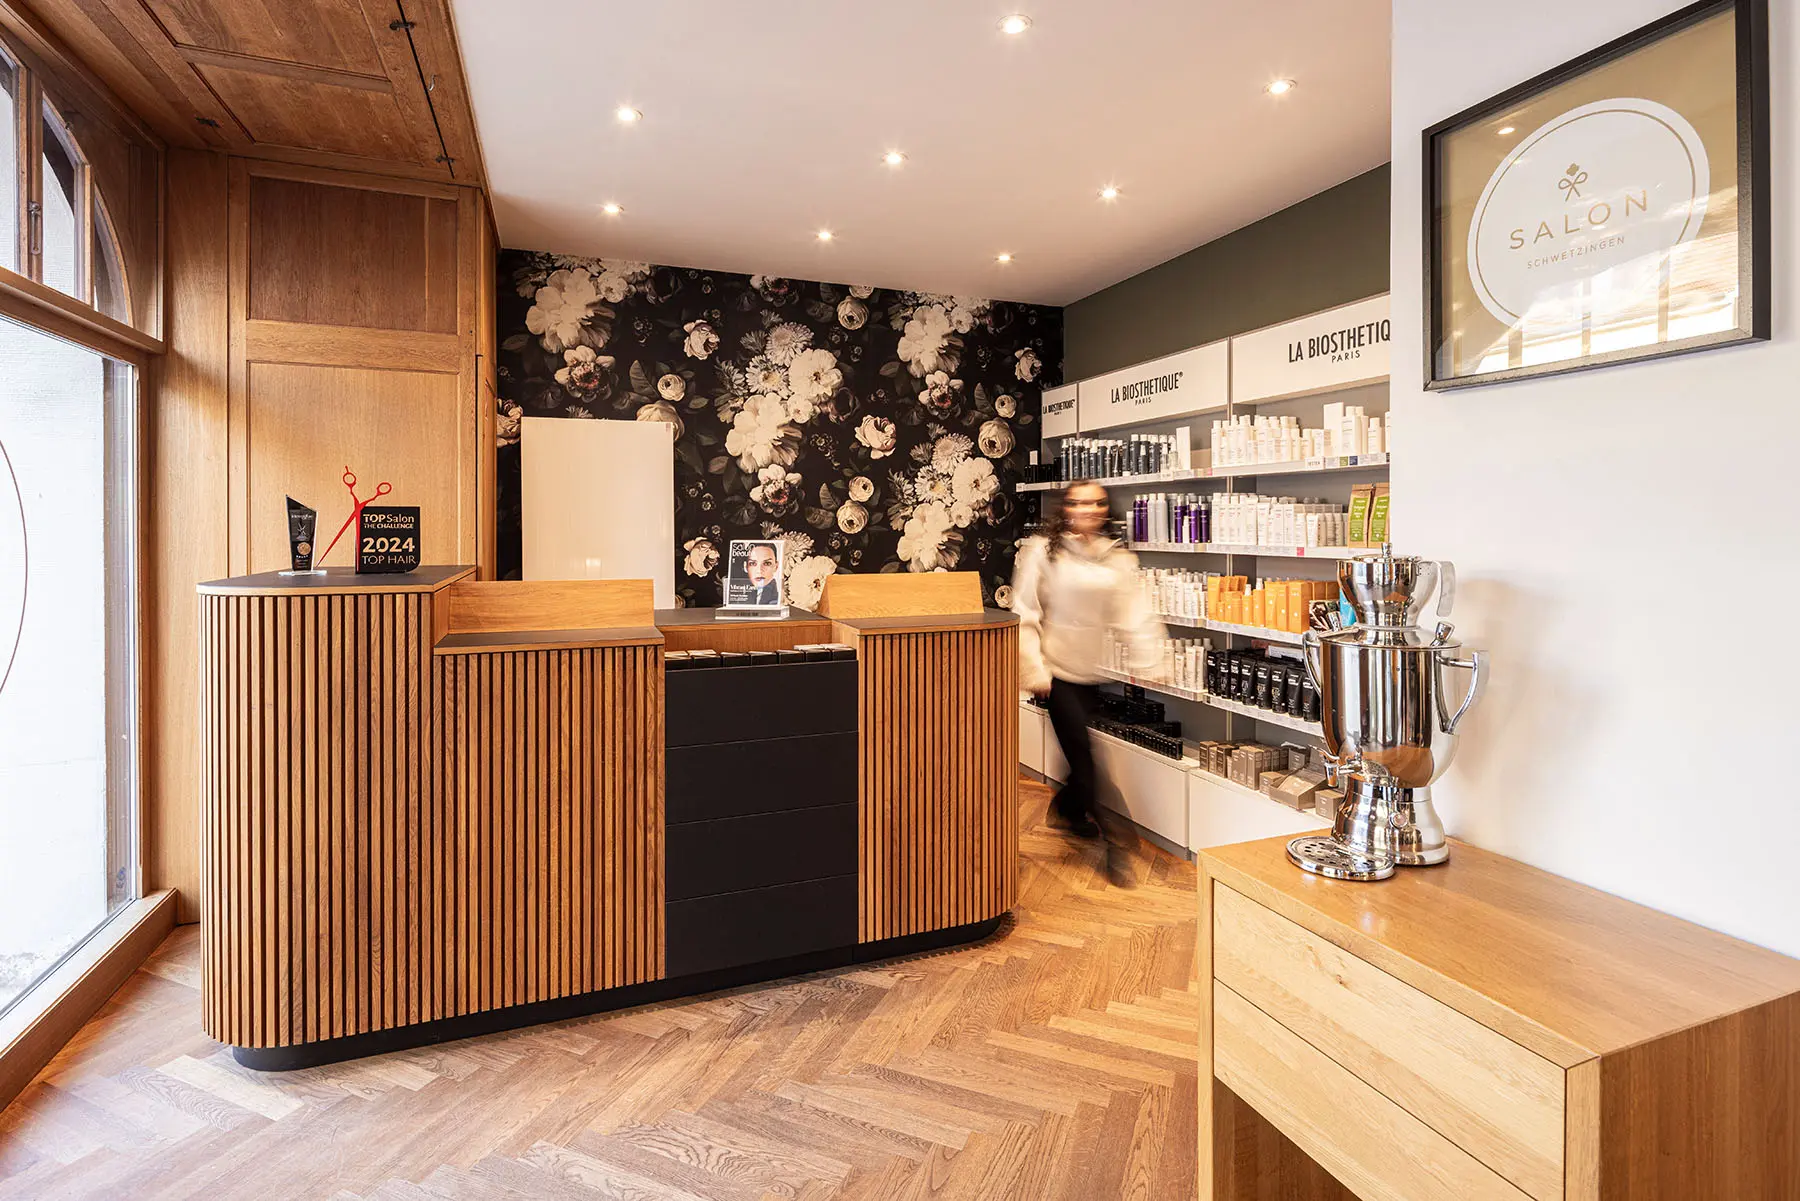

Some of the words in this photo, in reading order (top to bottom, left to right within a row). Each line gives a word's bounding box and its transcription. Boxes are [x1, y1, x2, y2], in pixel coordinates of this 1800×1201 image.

[1510, 190, 1647, 249] SALON
[1527, 236, 1625, 269] SCHWETZINGEN
[1289, 341, 1304, 363] LA
[1331, 350, 1361, 363] PARIS
[1111, 388, 1121, 404] LA
[1135, 397, 1152, 406] PARIS
[362, 537, 416, 553] 2024
[361, 555, 385, 565] TOP
[387, 555, 416, 565] HAIR
